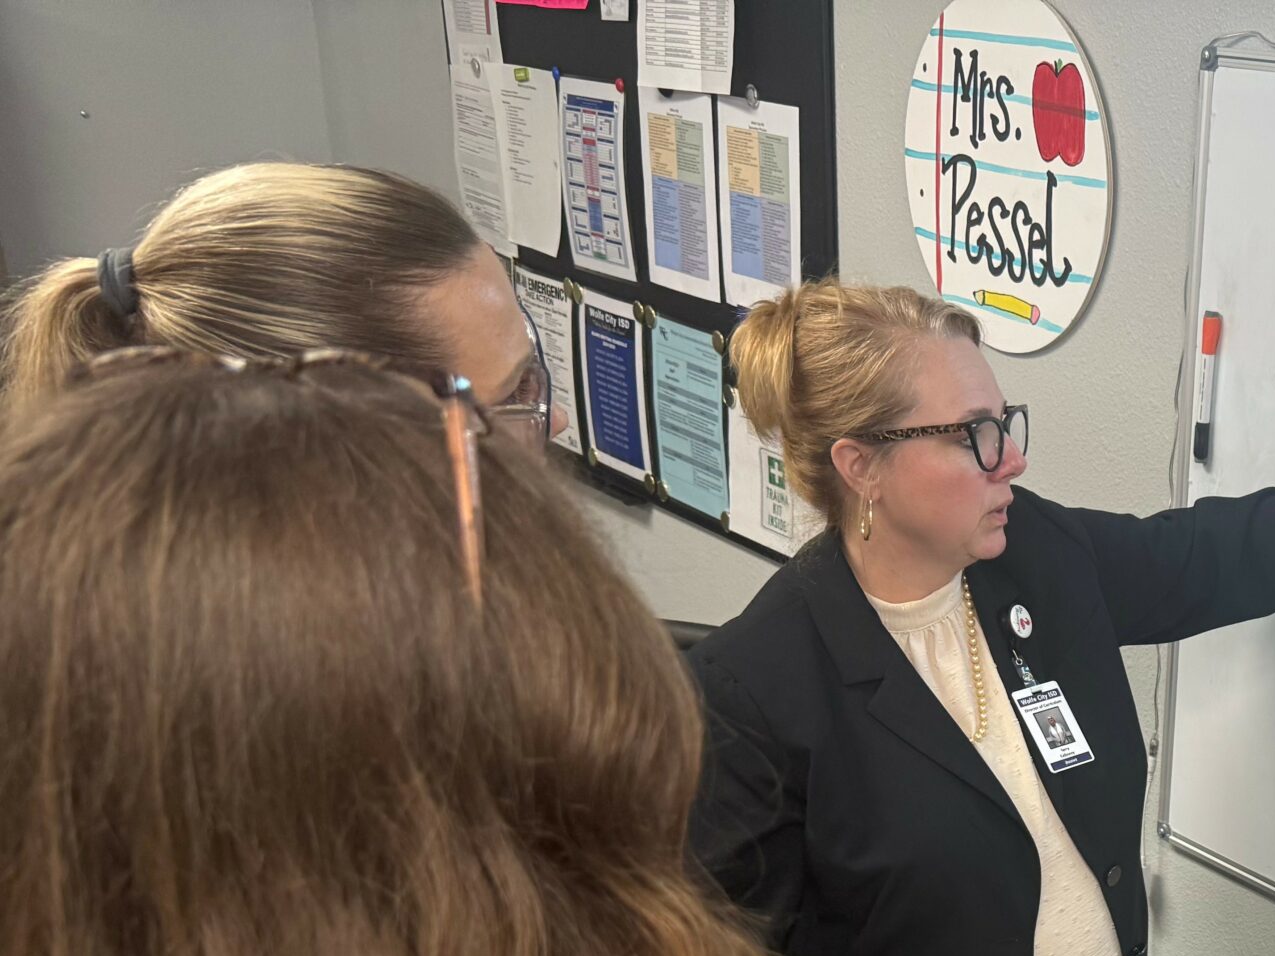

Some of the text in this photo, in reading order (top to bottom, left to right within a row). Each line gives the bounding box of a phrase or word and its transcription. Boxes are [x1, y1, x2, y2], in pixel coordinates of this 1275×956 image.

[950, 48, 1022, 149] Mrs.
[941, 154, 1072, 287] Pessel
[527, 277, 568, 302] EMERGENCY
[536, 293, 554, 306] ACTION
[589, 307, 605, 321] Wolfe
[605, 310, 617, 327] City
[618, 317, 630, 330] ISD
[773, 502, 782, 516] KIT
[768, 514, 787, 532] INSIDE
[1021, 690, 1057, 705] Wolfe City ISD
